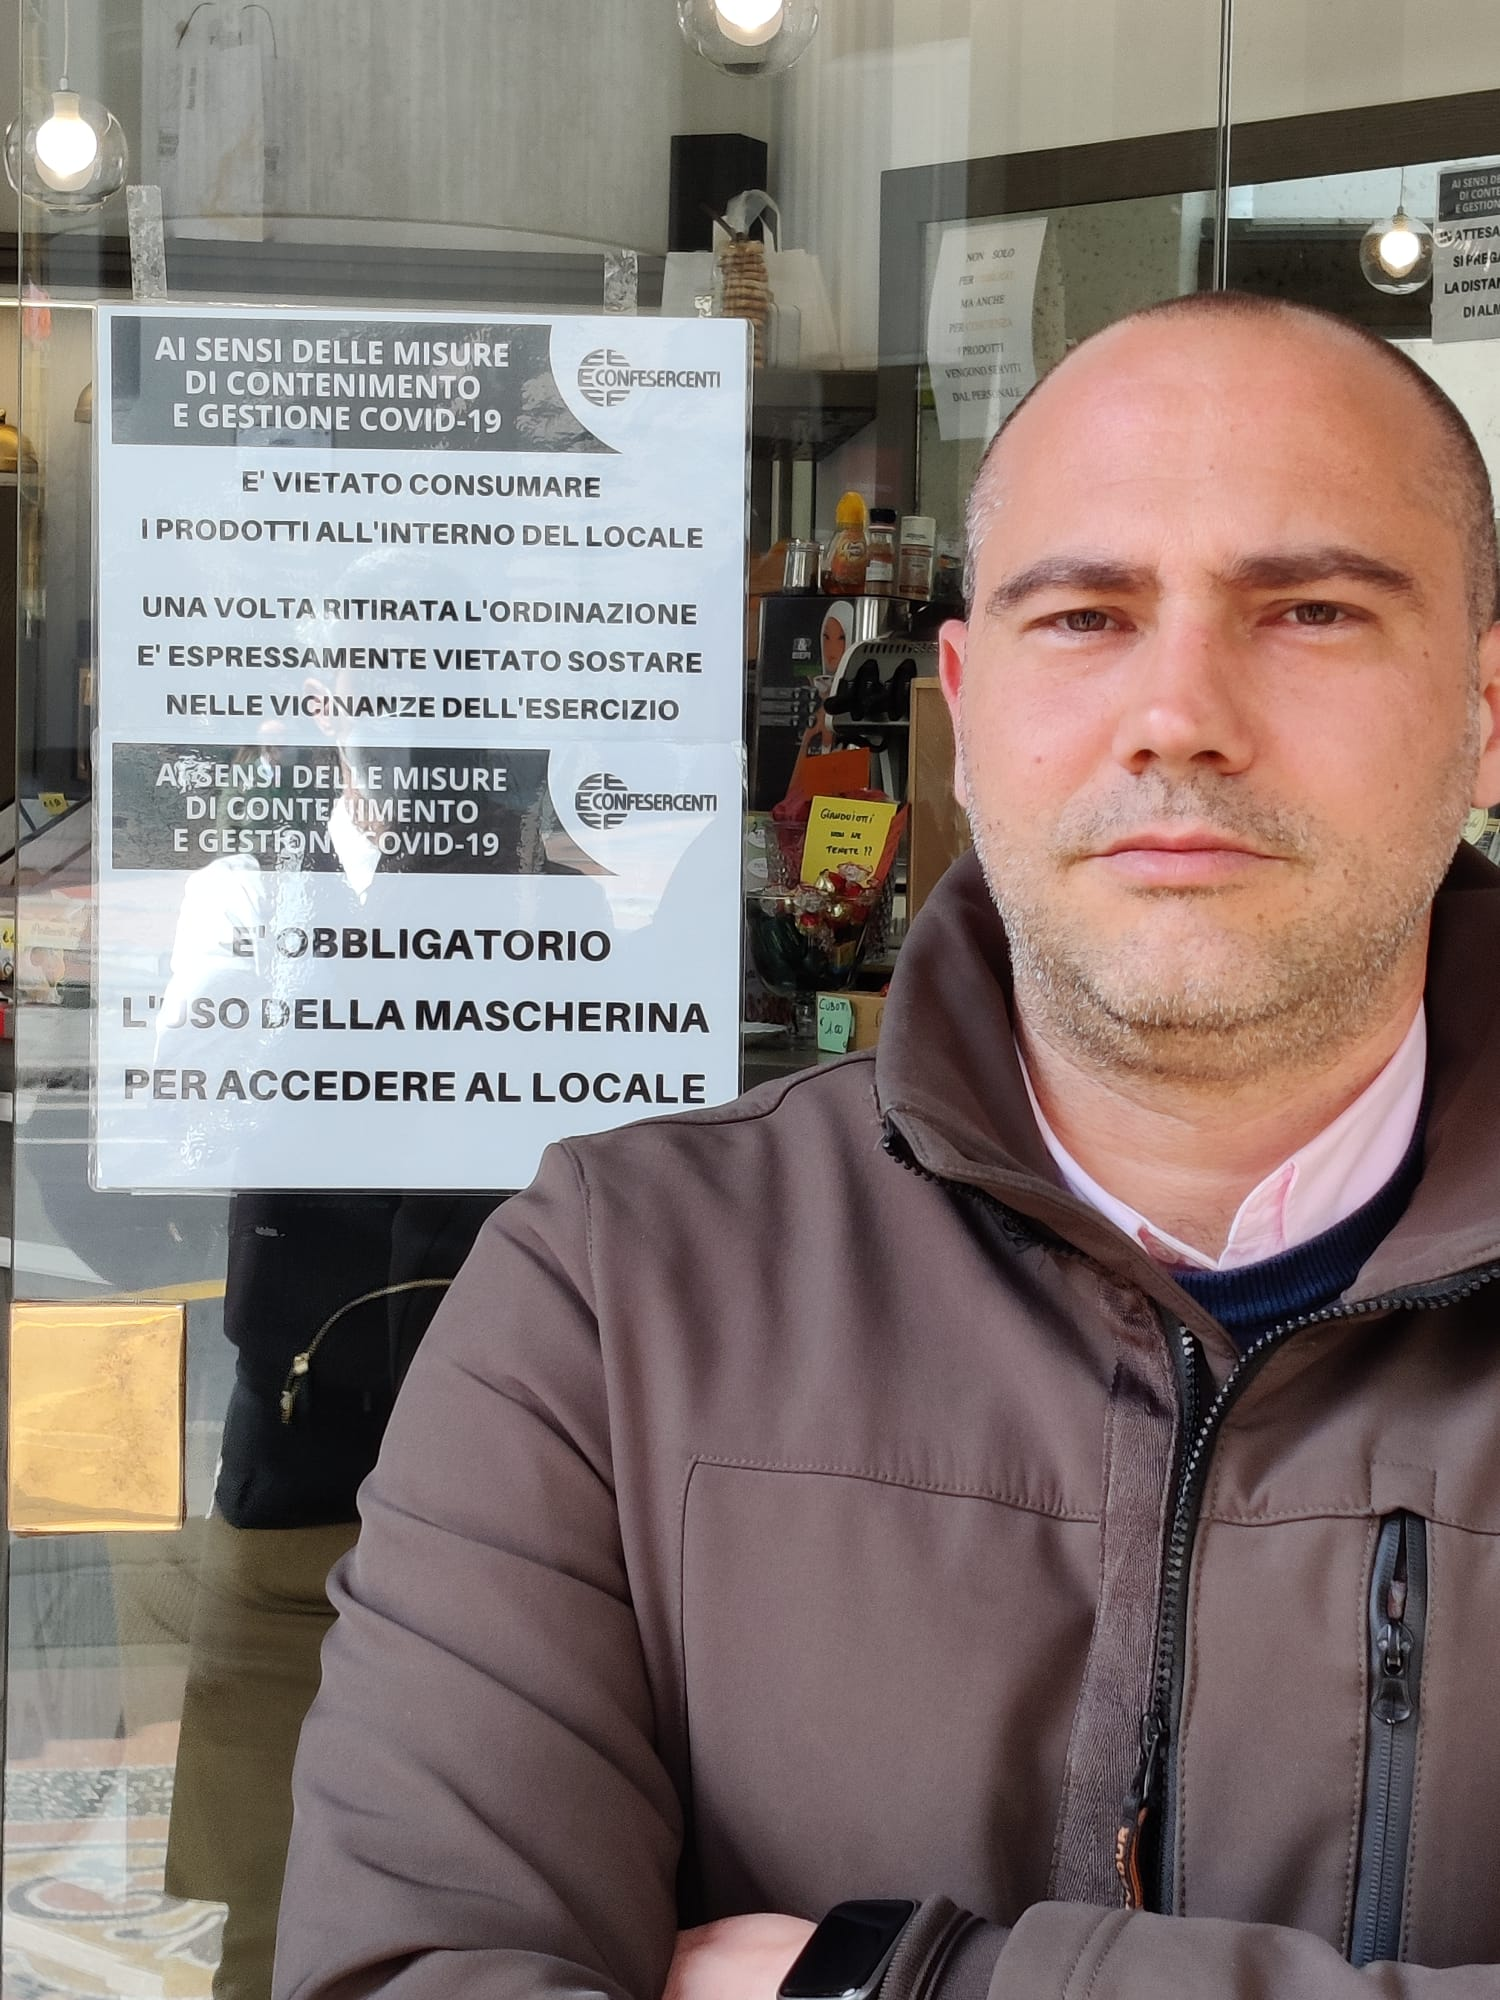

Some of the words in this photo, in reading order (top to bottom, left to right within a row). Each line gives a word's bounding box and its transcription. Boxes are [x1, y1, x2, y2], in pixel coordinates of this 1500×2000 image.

[1463, 175, 1489, 188] SENSI
[1453, 254, 1464, 268] SI
[1444, 281, 1460, 295] LA
[1463, 305, 1476, 318] DI
[155, 336, 185, 362] AI
[195, 337, 283, 364] SENSI
[292, 339, 384, 366] DELLE
[393, 341, 510, 369] MISURE
[962, 342, 1005, 357] PRODOTTI
[185, 370, 217, 395] DI
[225, 371, 482, 400] CONTENIMENTO
[971, 387, 1023, 401] PERSNALE
[174, 404, 189, 428] E
[198, 404, 351, 432] GESTIONE
[359, 406, 502, 434] COVID-19
[242, 471, 267, 494] E'
[274, 471, 403, 496] VIETATO
[409, 473, 601, 499] CONSUMARE
[140, 517, 149, 540] I
[155, 518, 310, 543] PRODOTTI
[315, 519, 515, 547] ALL'INTERNO
[521, 523, 579, 548] DEL
[585, 524, 704, 550] LOCALE
[141, 596, 209, 620] UNA
[213, 596, 315, 621] VOLTA
[323, 598, 460, 623] RITIRATA
[465, 599, 698, 626] L'ORDINAZIONE
[137, 643, 162, 667] E'
[168, 644, 427, 671] ESPRESSAMENTE
[432, 647, 562, 673] VIETATO
[567, 649, 703, 675] SOSTARE
[166, 693, 263, 717] NELLE
[269, 694, 436, 719] VICINANZE
[441, 695, 680, 723] DELL'ESERCIZIO
[194, 763, 282, 789] SENSI
[292, 765, 383, 790] DELLE
[392, 766, 507, 792] MISURE
[186, 796, 217, 820] DI
[226, 797, 479, 824] CONTEIMENTO
[174, 828, 189, 852] E
[198, 829, 350, 856] GESTION
[358, 831, 500, 856] OVID-19
[232, 925, 266, 957] E'
[276, 927, 611, 961] OBBLIGATORIO
[261, 998, 404, 1032] DELLA
[414, 1000, 710, 1034] MASCHERINA
[124, 1069, 208, 1100] PER
[215, 1069, 456, 1102] ACCEDERE
[465, 1072, 521, 1102] AL
[532, 1072, 705, 1104] LOCALE
